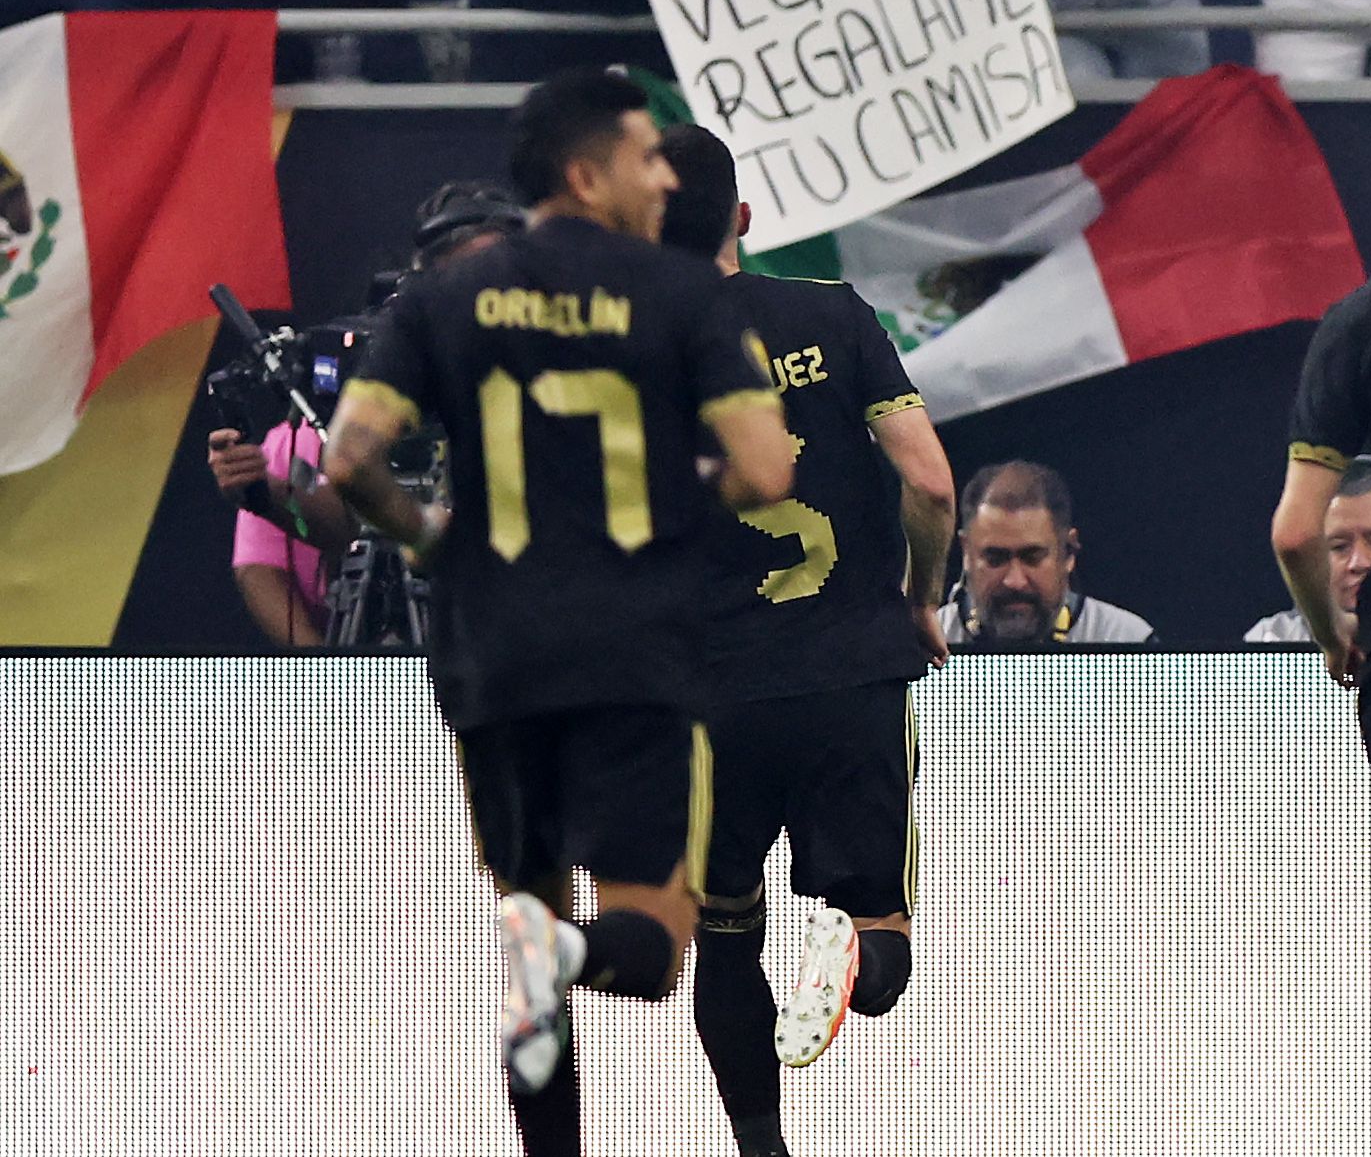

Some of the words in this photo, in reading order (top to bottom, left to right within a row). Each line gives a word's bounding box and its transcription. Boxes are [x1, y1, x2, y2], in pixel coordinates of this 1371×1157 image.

[738, 136, 848, 217] TU
[855, 25, 1063, 184] CAMISA
[479, 366, 654, 563] 17
